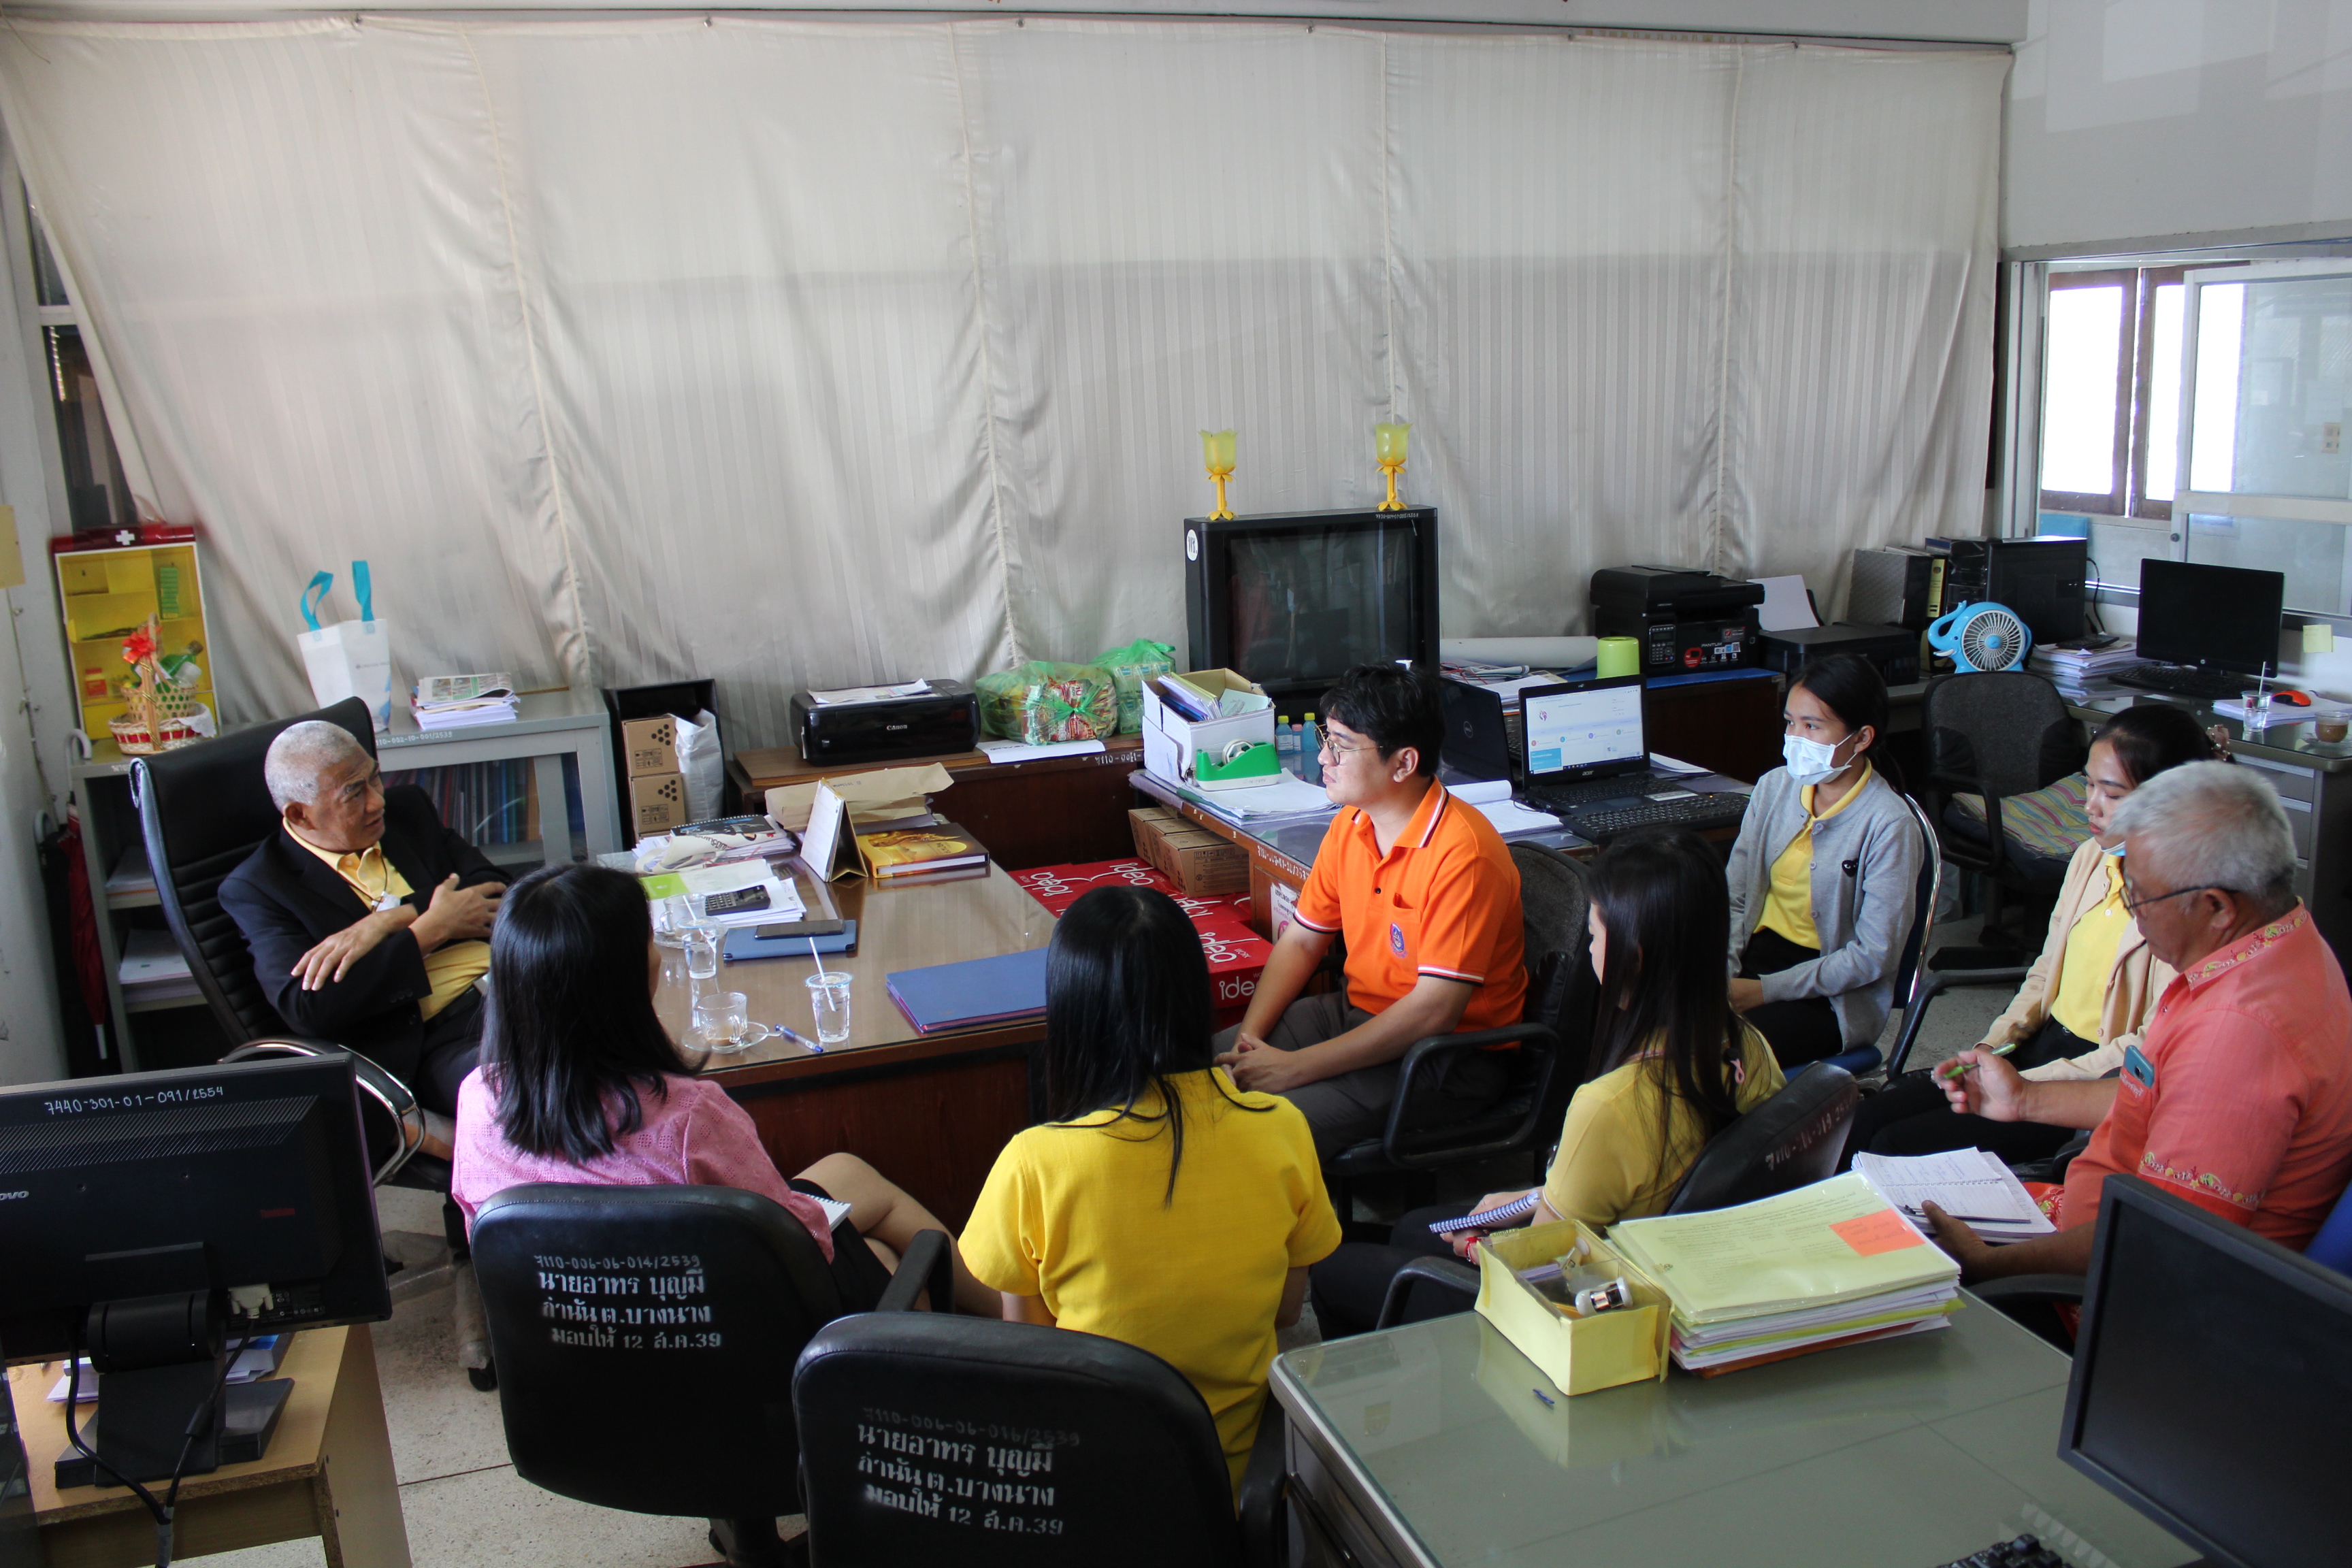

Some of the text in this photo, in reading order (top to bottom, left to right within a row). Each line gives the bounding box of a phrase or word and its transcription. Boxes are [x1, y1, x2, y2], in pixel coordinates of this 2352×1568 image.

[376, 731, 453, 747] 110-002-10-001/2539
[1219, 976, 1258, 1000] ide
[0, 1191, 29, 1200] ovo
[538, 1269, 705, 1301] นายอาทร บุญมี
[550, 1324, 617, 1348] มอบให้
[623, 1335, 643, 1349] 12
[858, 1424, 1054, 1477] นายอาทร บุญมี
[865, 1484, 943, 1518] มอบให้
[949, 1506, 971, 1525] 12
